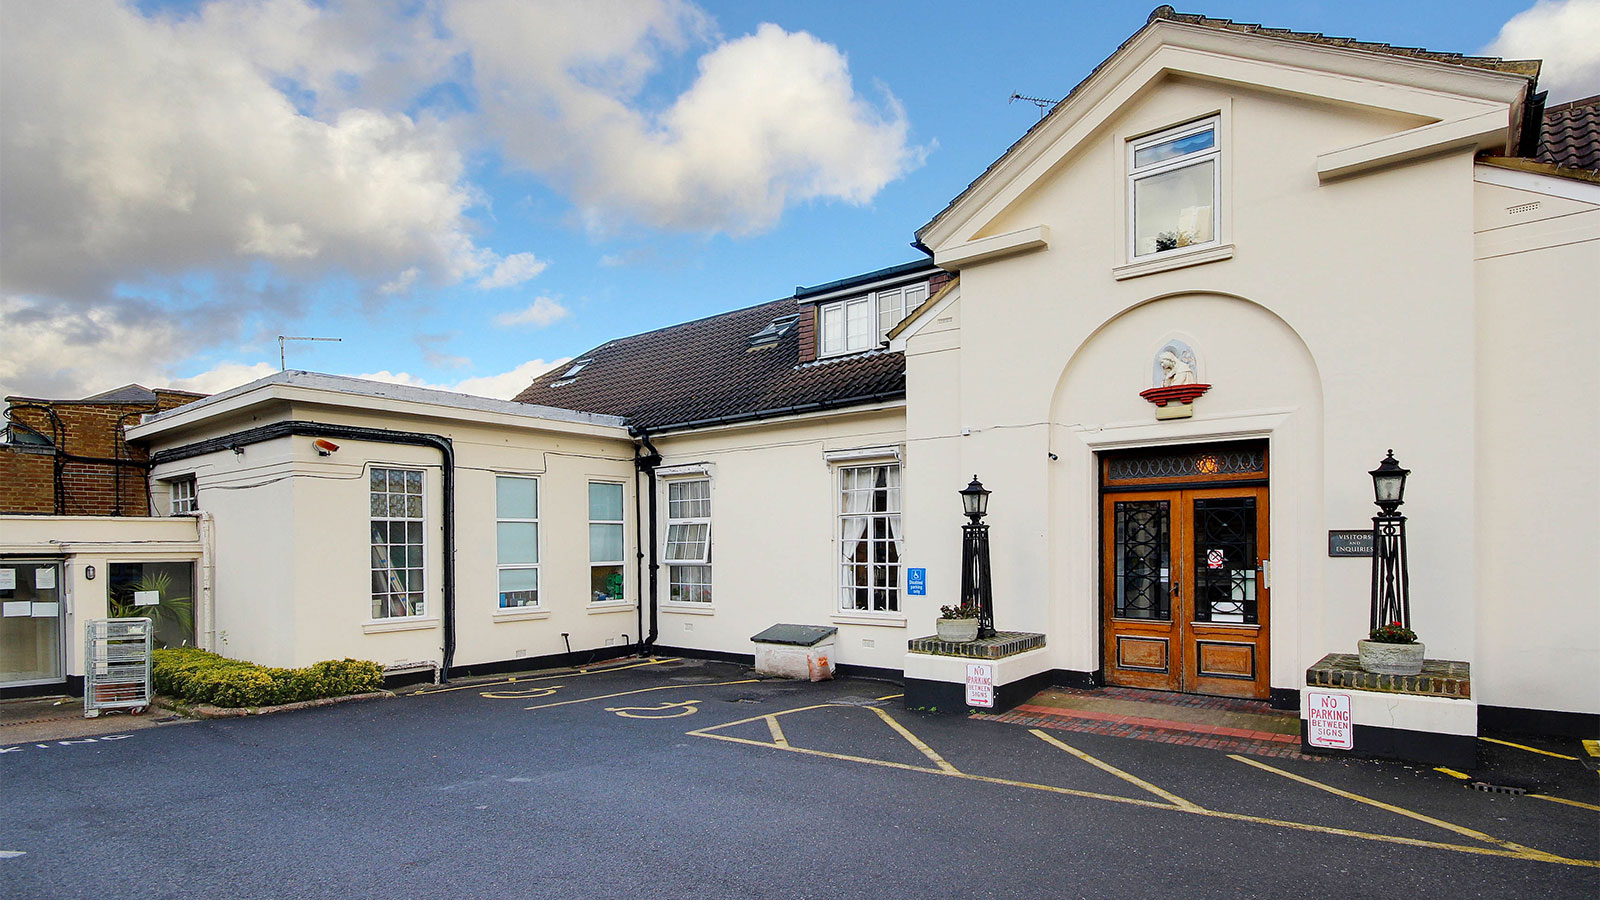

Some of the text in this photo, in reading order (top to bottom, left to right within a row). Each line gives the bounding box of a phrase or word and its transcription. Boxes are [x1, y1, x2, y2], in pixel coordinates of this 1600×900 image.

[968, 676, 991, 685] PARKING
[1321, 698, 1337, 708] NO
[1311, 708, 1348, 721] PARKING
[1312, 720, 1348, 729] BETWEEN
[1318, 728, 1342, 737] SIGNS
